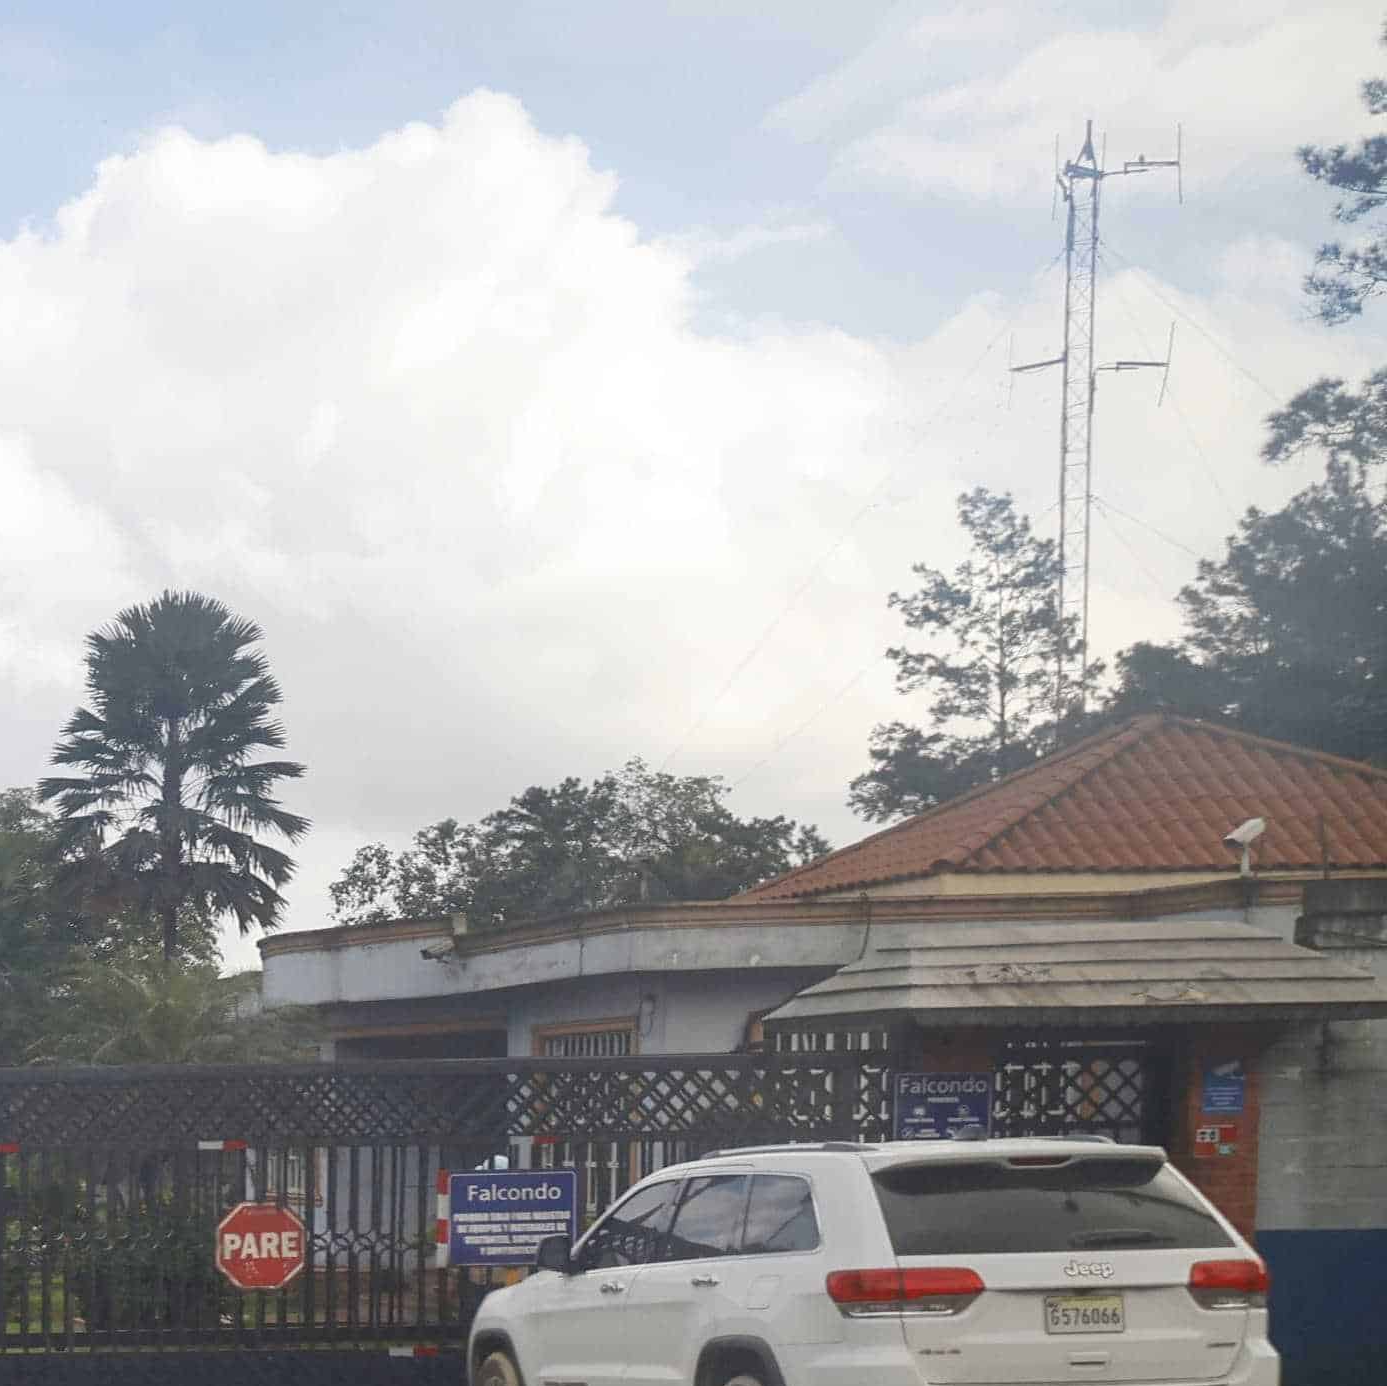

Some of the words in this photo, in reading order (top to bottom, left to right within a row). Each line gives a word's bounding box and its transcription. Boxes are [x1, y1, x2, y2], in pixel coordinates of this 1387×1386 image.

[900, 1077, 987, 1094] Falcondo
[468, 1182, 562, 1201] Falcondo
[223, 1231, 300, 1260] PARE
[1064, 1259, 1114, 1278] Jeep
[1050, 1307, 1121, 1326] G576066
